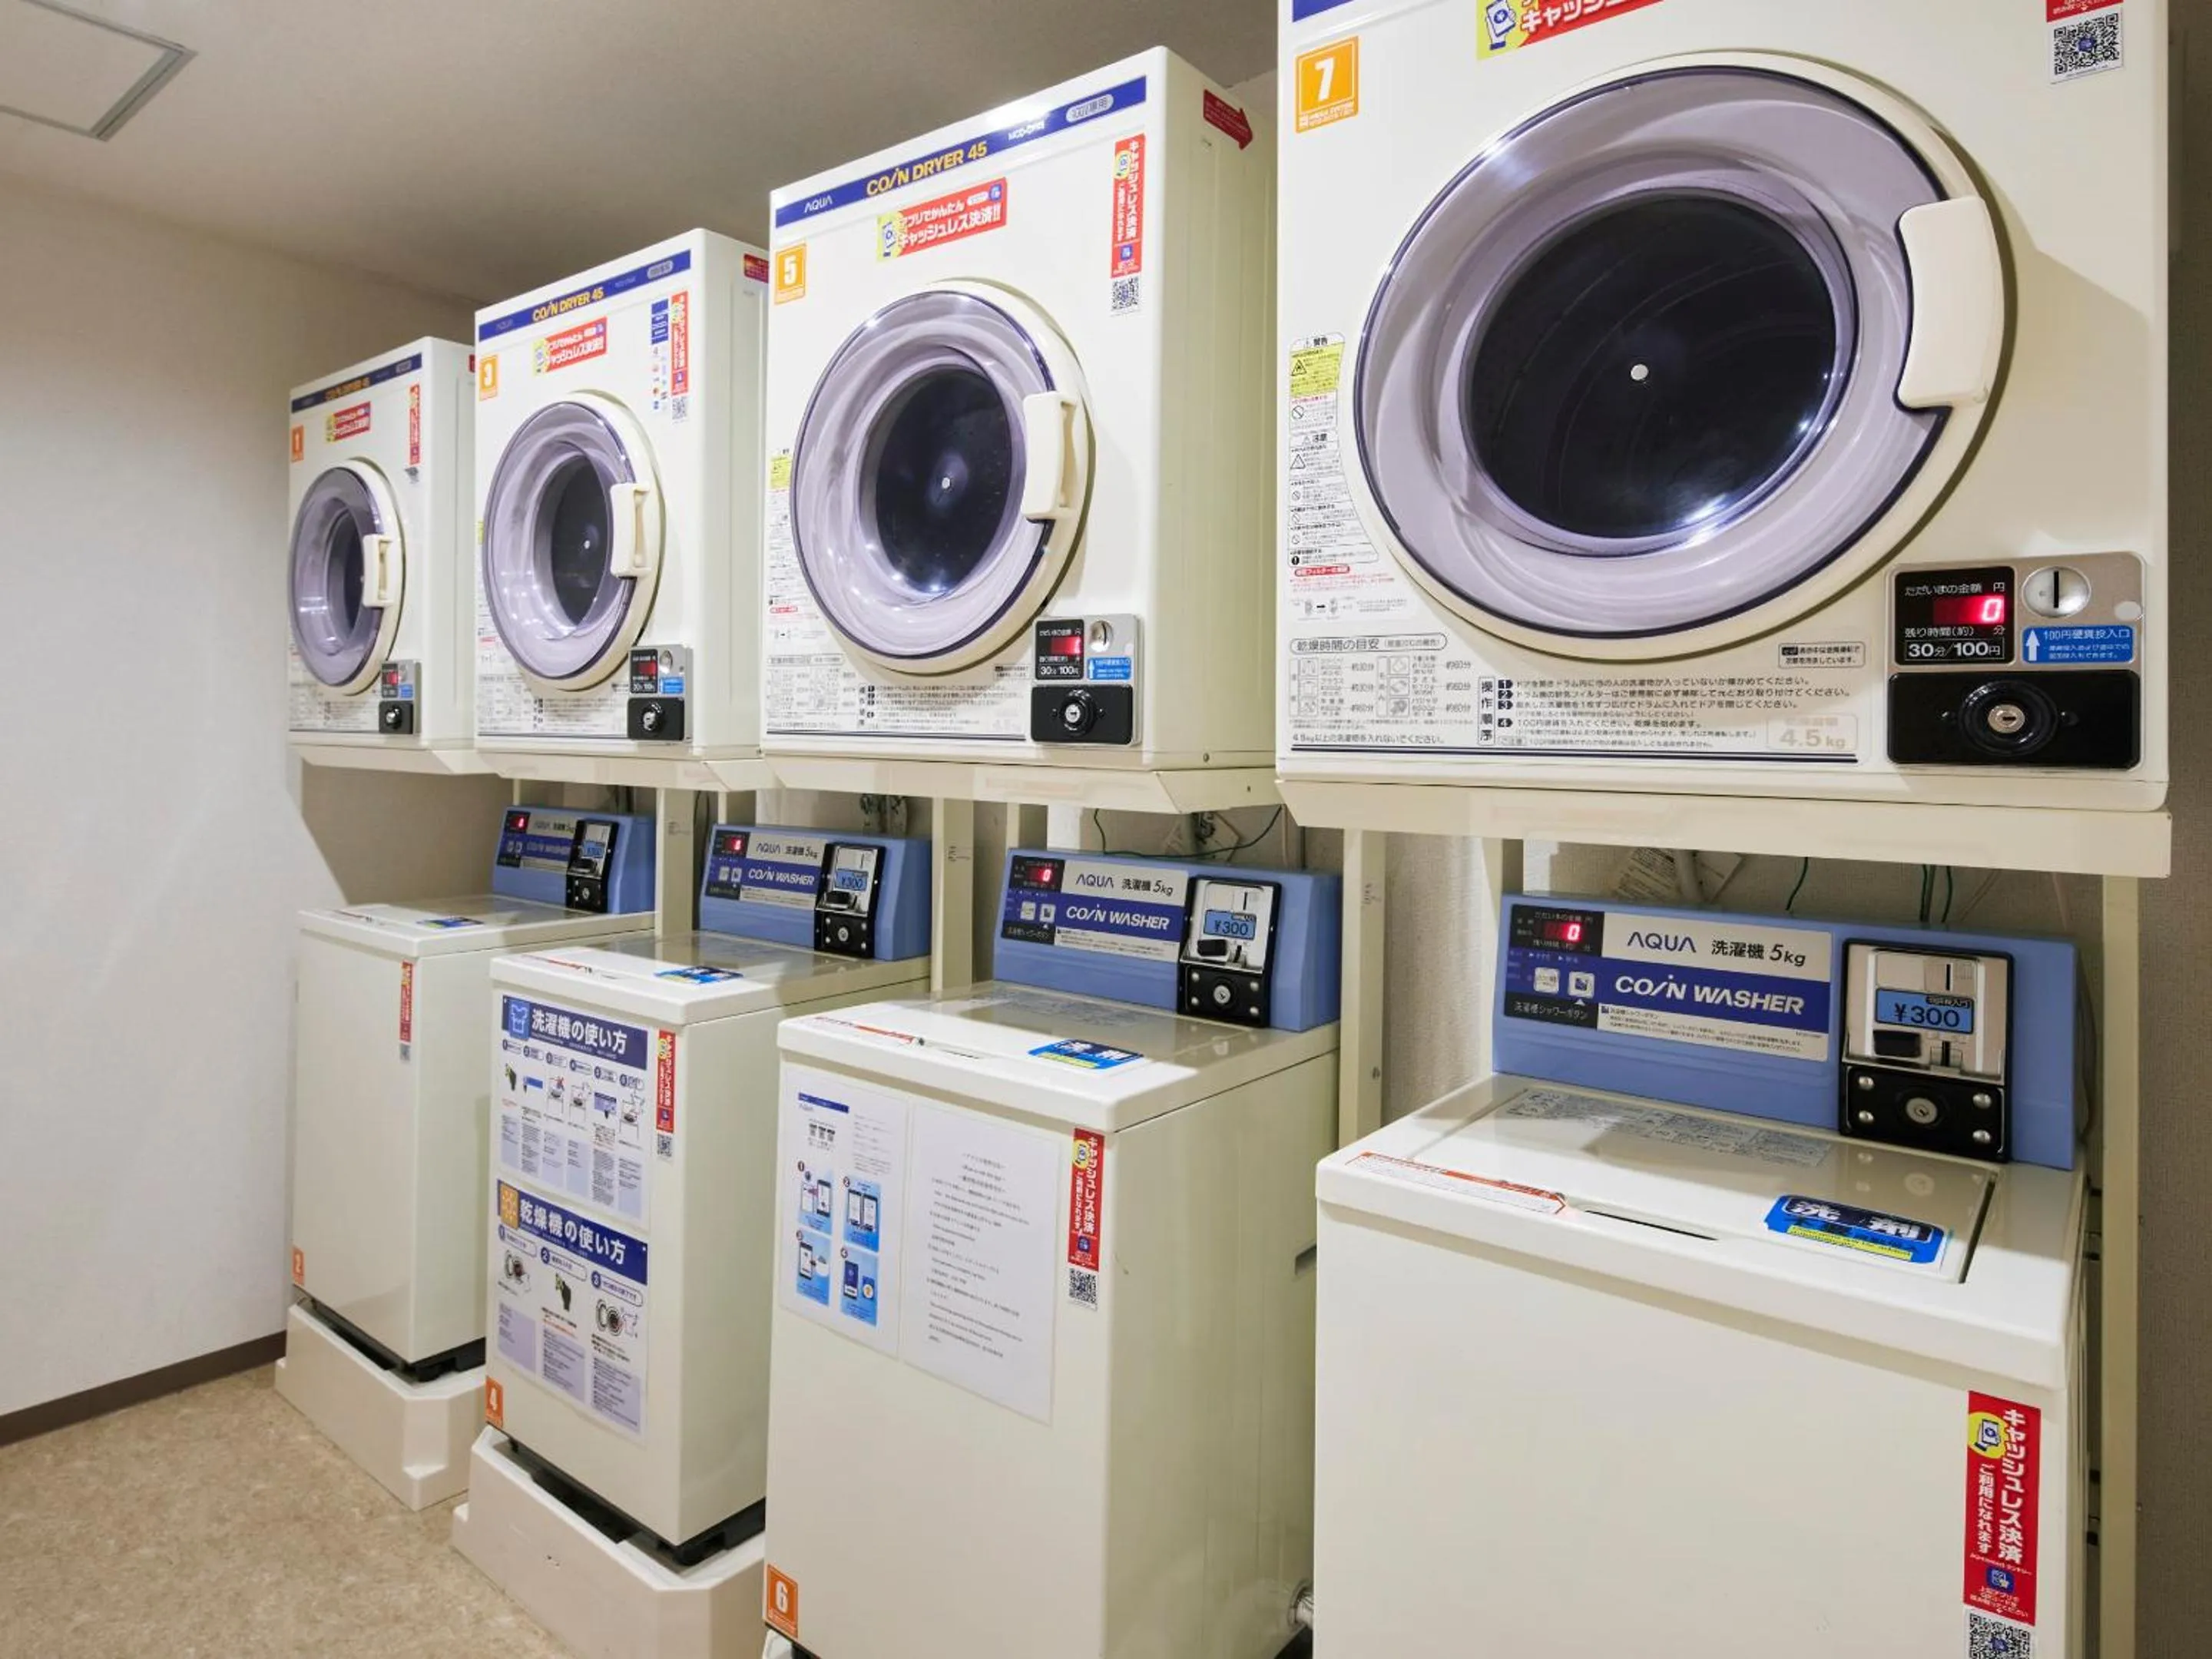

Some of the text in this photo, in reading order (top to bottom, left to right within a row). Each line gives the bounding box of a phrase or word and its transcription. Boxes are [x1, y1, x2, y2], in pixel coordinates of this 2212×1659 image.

[1313, 58, 1335, 102] 7
[912, 148, 963, 181] DRYER
[968, 141, 988, 161] 45
[804, 194, 833, 214] AQUA
[783, 256, 796, 285] 5
[1993, 581, 2005, 593] 円
[1981, 598, 2002, 623] 0
[1908, 641, 2001, 658] 30分/100円
[775, 873, 816, 886] WASHER
[1075, 873, 1174, 897] AQUA 洗濯機 5kg
[1109, 910, 1171, 931] WASHER
[1214, 919, 1249, 936] ¥300
[1567, 923, 1581, 942] 0
[1627, 931, 1806, 967] AQUA 洗濯機 5kg
[1694, 984, 1805, 1015] WASHER
[1894, 1002, 1961, 1028] ¥300
[531, 1008, 628, 1055] 洗濯機の使い方
[519, 1199, 627, 1266] 乾燥機の使い方
[1998, 1408, 2027, 1565] キャッシュレス決済
[1977, 1463, 1995, 1555] ご利用になれます
[776, 1580, 788, 1614] 6
